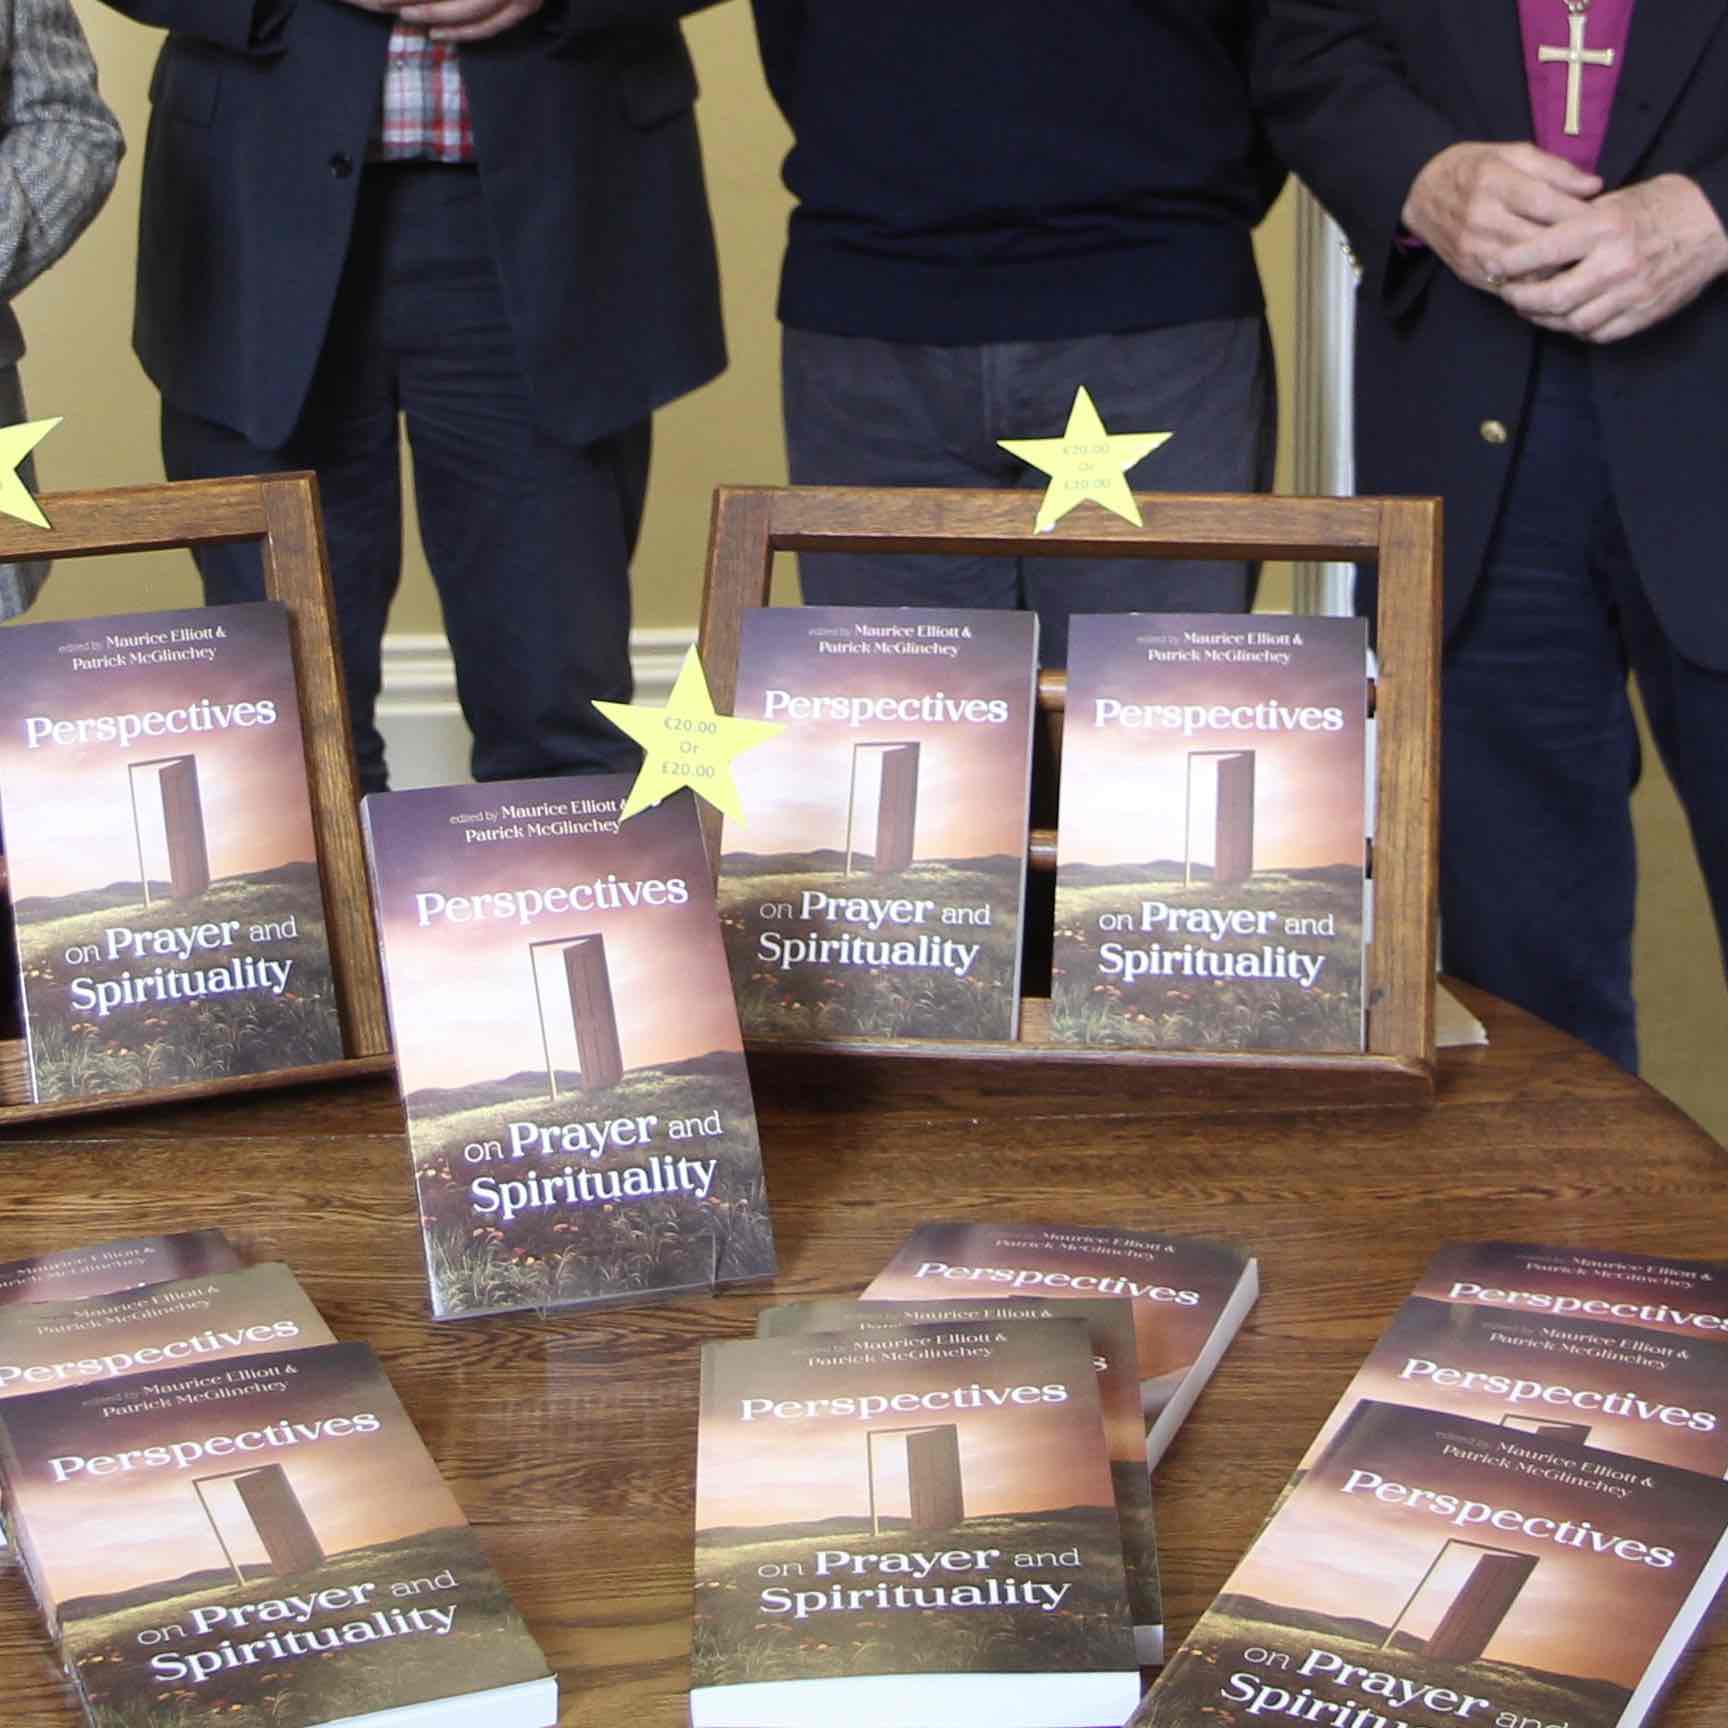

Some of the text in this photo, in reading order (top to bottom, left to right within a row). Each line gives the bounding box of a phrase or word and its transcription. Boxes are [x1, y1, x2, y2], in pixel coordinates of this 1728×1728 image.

[106, 633, 167, 649] Maurice
[171, 628, 212, 642] Elliott
[215, 626, 227, 638] &
[819, 641, 959, 658] Patrick McGlinchey
[854, 624, 915, 638] Maurice
[917, 625, 959, 638] Elliott
[961, 626, 971, 638] &
[1183, 632, 1245, 645] Maurice
[1248, 632, 1290, 645] Elliott
[1292, 633, 1304, 646] &
[72, 645, 217, 671] Patrick McGlinchey
[1148, 649, 1292, 664] Patrick McGlinchey
[24, 699, 276, 749] Perspectives
[664, 717, 717, 734] €20.00
[764, 689, 1008, 727] Perspectives
[1095, 698, 1344, 735] Perspectives
[679, 741, 699, 753] Or
[662, 761, 715, 778] £20.00
[485, 810, 499, 823] by
[501, 803, 568, 820] Maurice
[571, 799, 616, 814] Elliott
[465, 819, 621, 843] Patrick McGlinchey
[416, 874, 689, 927] Perspectives
[759, 891, 991, 930] on Prayer and
[65, 915, 298, 964] on Prayer and
[1098, 901, 1335, 941] on Prayer and
[758, 931, 980, 975] Spirituality
[1098, 943, 1326, 987] Spirituality
[71, 956, 293, 1016] Spirituality
[464, 1110, 722, 1162] on Prayer and
[472, 1155, 717, 1220] Spirituality
[72, 1299, 149, 1320] Maurice
[151, 1287, 202, 1305] Elliott
[202, 1285, 220, 1294] &
[913, 1262, 1201, 1306] Perspectives
[36, 1319, 103, 1336] Patrick
[105, 1299, 210, 1327] McGlinchey
[903, 1309, 979, 1320] Maurice
[983, 1308, 1041, 1319] Elliott
[808, 1346, 993, 1367] Patrick McGlinchey
[853, 1336, 931, 1351] Maurice
[936, 1334, 991, 1344] Elliott
[994, 1333, 1008, 1342] &
[1489, 1332, 1672, 1371] Patrick McGlinchey
[1538, 1326, 1617, 1347] Maurice
[1619, 1338, 1676, 1358] Elliott
[1676, 1349, 1691, 1361] &
[102, 1396, 172, 1418] Patrick
[176, 1379, 289, 1406] McGlinchey
[143, 1363, 299, 1396] Maurice Elliott &
[1399, 1357, 1718, 1432] Perspectives
[740, 1382, 1068, 1422] Perspectives
[48, 1410, 381, 1482] Perspectives
[1498, 1439, 1577, 1468] Maurice
[1580, 1460, 1639, 1485] Elliott
[1640, 1476, 1658, 1489] &
[1442, 1443, 1632, 1500] Patrick McGlinchey
[1341, 1469, 1677, 1569] Perspectives
[757, 1548, 1083, 1578] on Prayer and
[137, 1569, 459, 1645] on Prayer and
[759, 1577, 1071, 1619] Spirituality
[150, 1604, 457, 1684] Spirituality
[1243, 1647, 1290, 1671] on
[1298, 1648, 1490, 1719] Prayer
